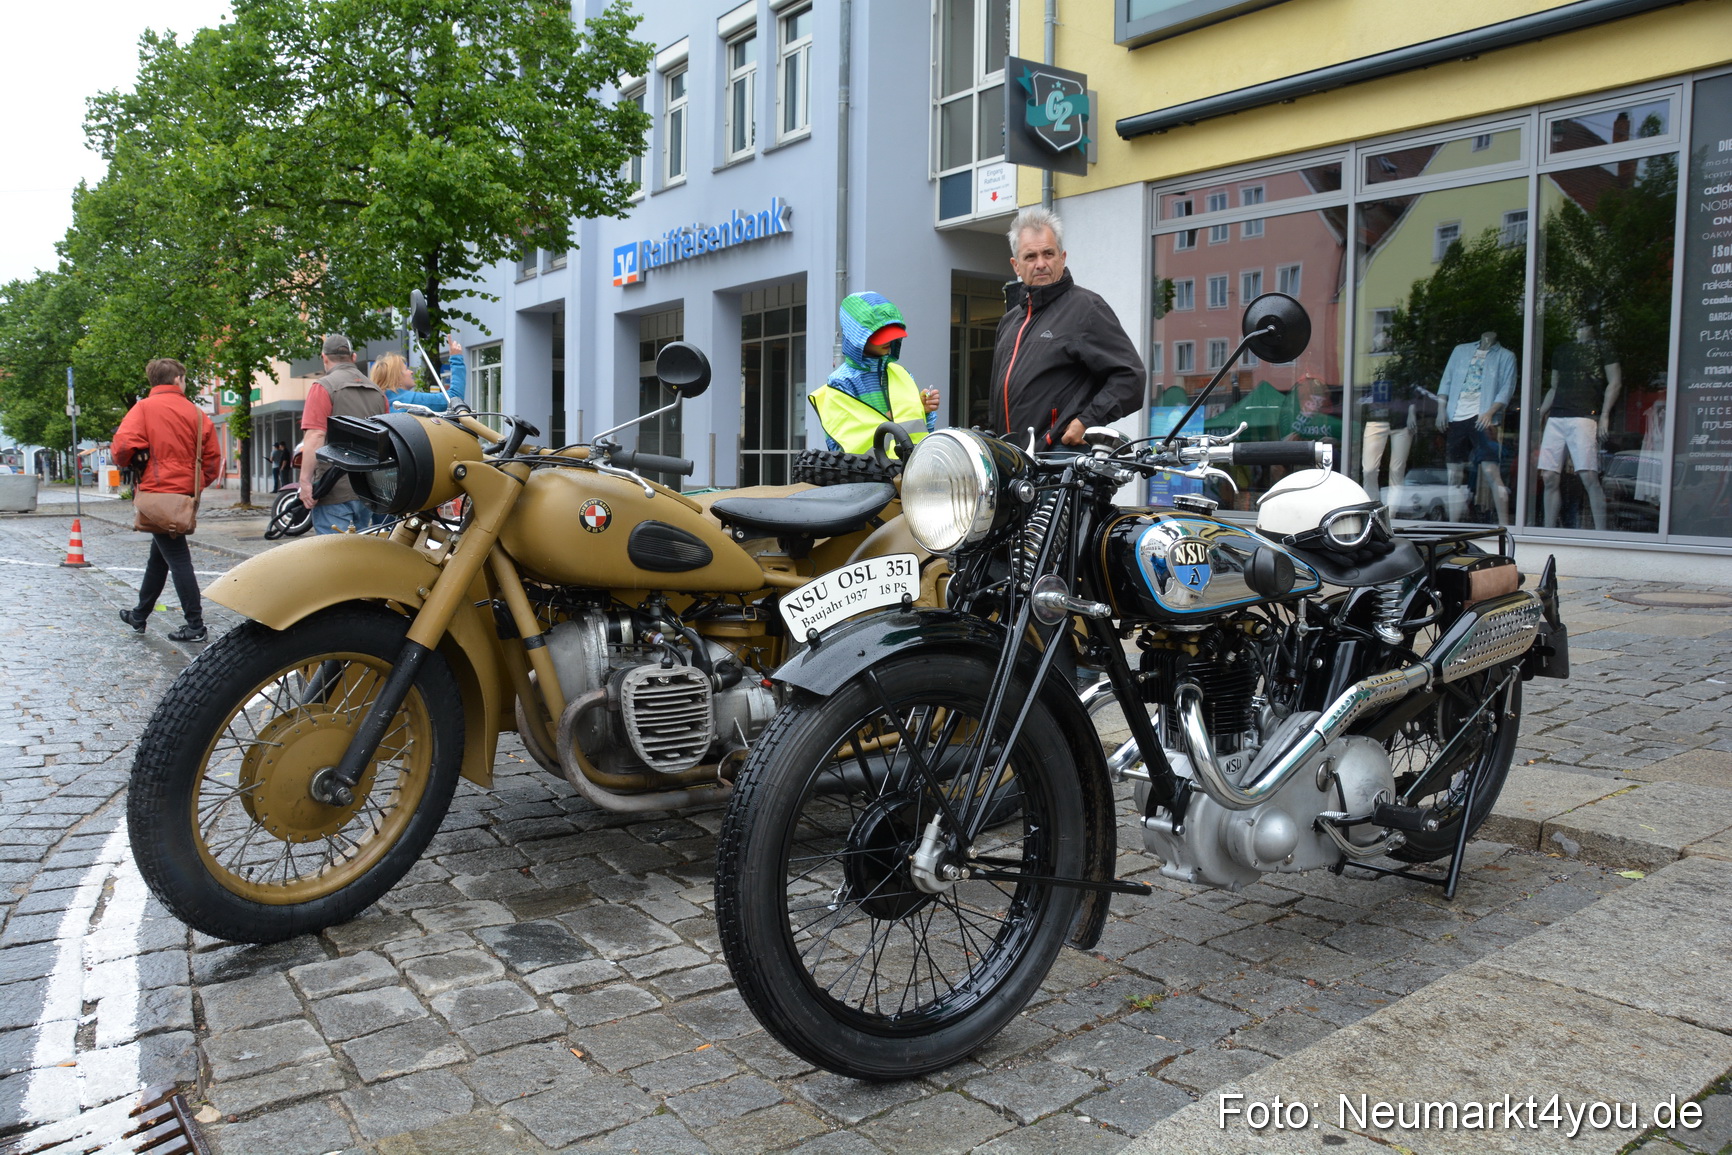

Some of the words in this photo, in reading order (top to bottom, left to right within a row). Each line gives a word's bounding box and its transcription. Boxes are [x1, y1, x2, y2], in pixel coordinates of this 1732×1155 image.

[1045, 90, 1073, 132] G2
[642, 196, 790, 270] Raiffeisenbank
[1711, 263, 1732, 274] COLM
[1174, 542, 1206, 565] NSU
[785, 580, 829, 619] NSU
[837, 564, 877, 589] OSL
[886, 559, 913, 577] 351
[801, 599, 843, 628] Baujahr
[844, 588, 868, 606] 1937
[879, 583, 891, 595] 18
[894, 582, 908, 593] PS
[1225, 758, 1242, 773] NSU
